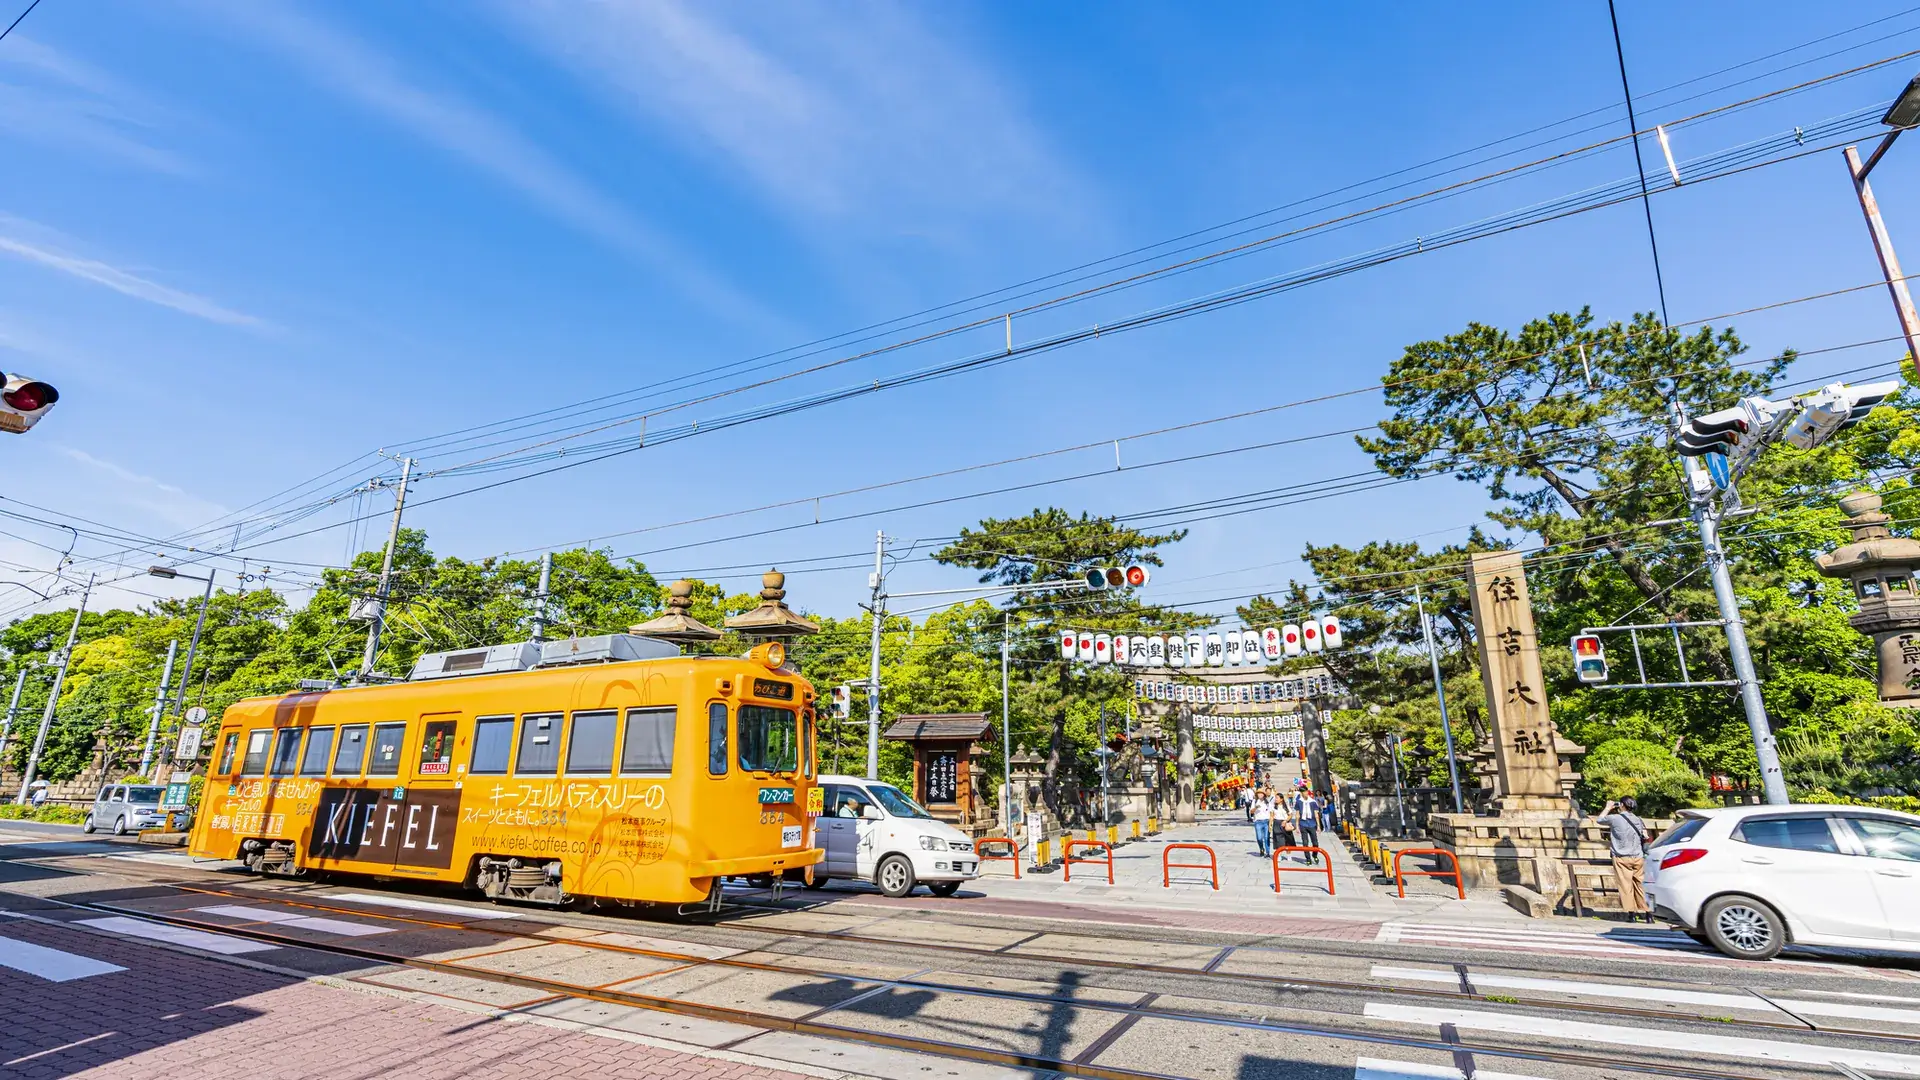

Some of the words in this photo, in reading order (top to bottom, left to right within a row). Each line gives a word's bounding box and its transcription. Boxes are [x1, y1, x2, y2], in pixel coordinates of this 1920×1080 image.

[1132, 640, 1259, 659] 天皇陛下御即位
[1487, 575, 1547, 756] 住吉大社
[225, 799, 262, 812] キーフェルの
[489, 783, 665, 810] キーフェルパティスリーの
[759, 789, 794, 802] ワンマンカー
[323, 802, 440, 850] KIEFEL
[462, 807, 540, 827] スイーツとともに。
[760, 810, 785, 825] 354
[471, 834, 602, 858] www.kiefel-coffee.co.jp
